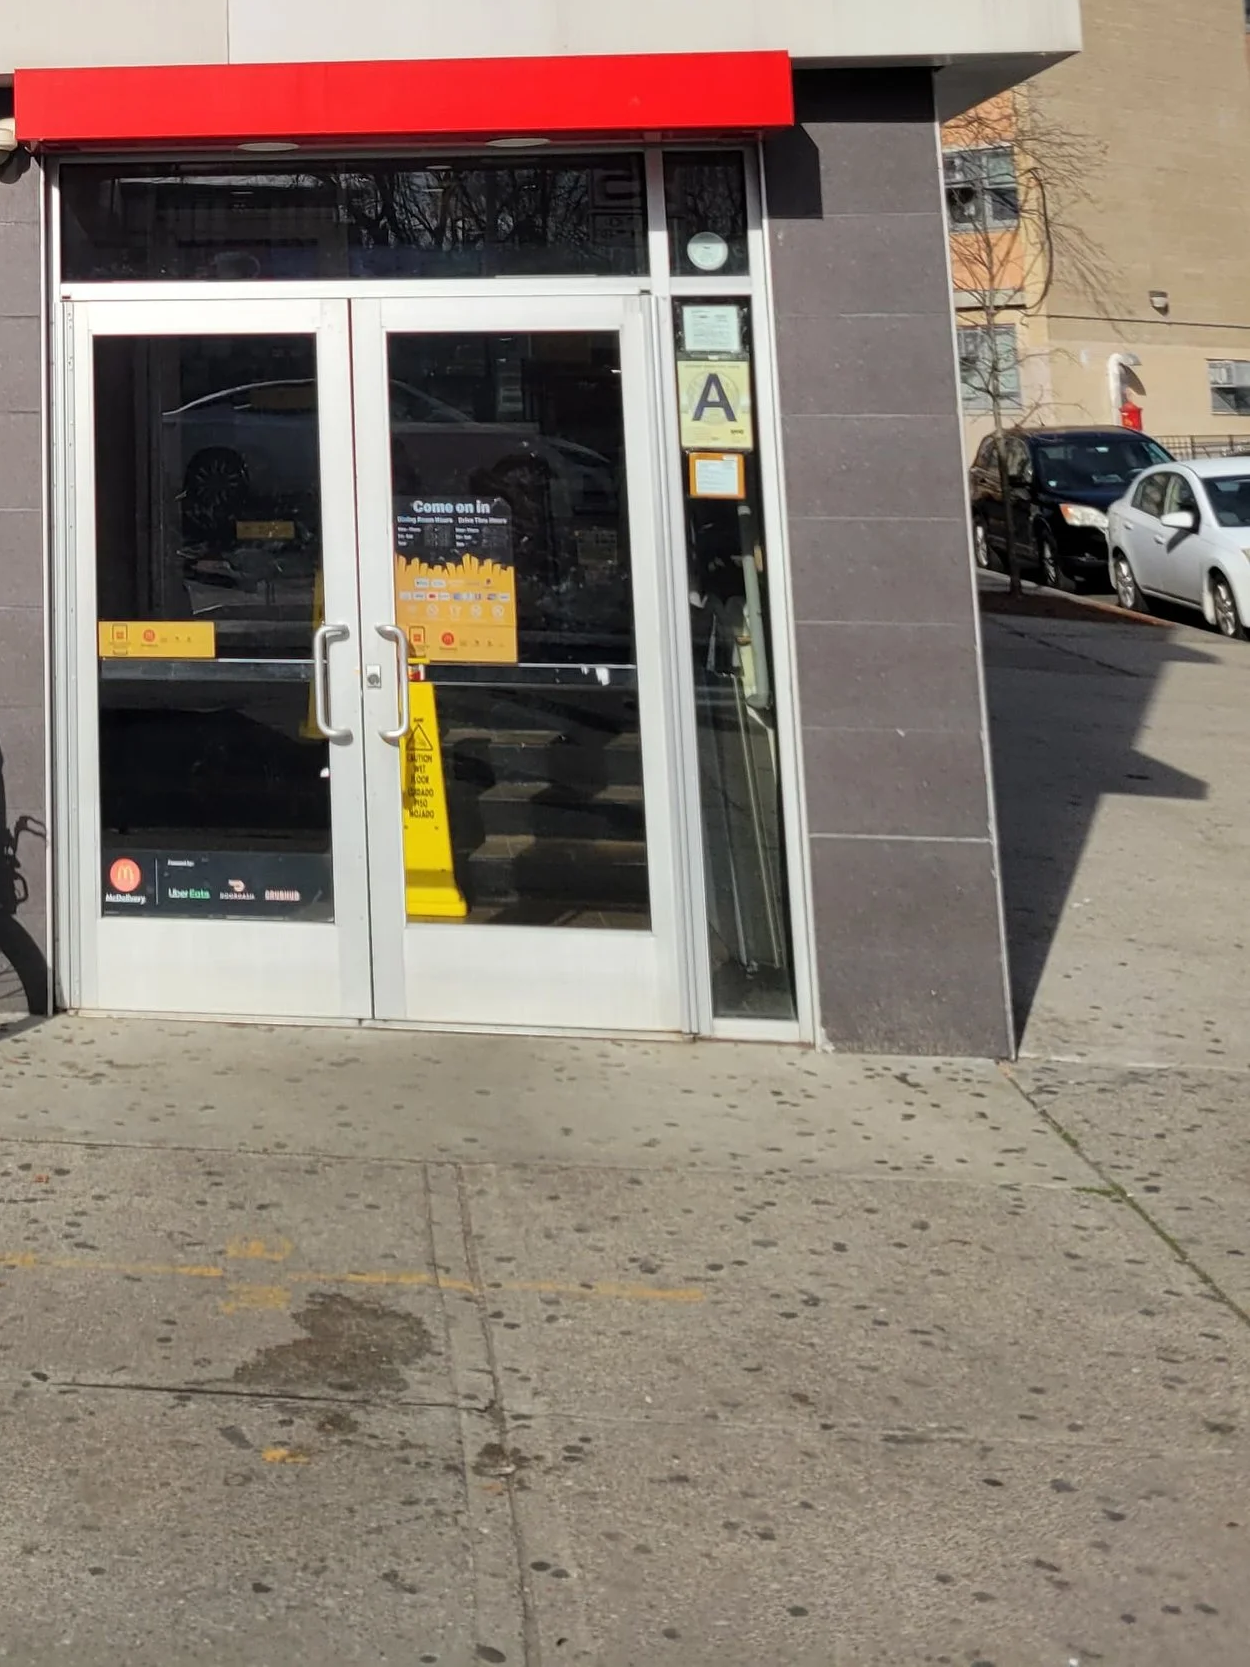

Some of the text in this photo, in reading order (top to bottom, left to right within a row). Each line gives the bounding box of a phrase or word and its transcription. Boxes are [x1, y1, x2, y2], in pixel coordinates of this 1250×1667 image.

[692, 372, 738, 422] A
[413, 499, 491, 514] Come on in
[168, 887, 210, 900] Uber Eats
